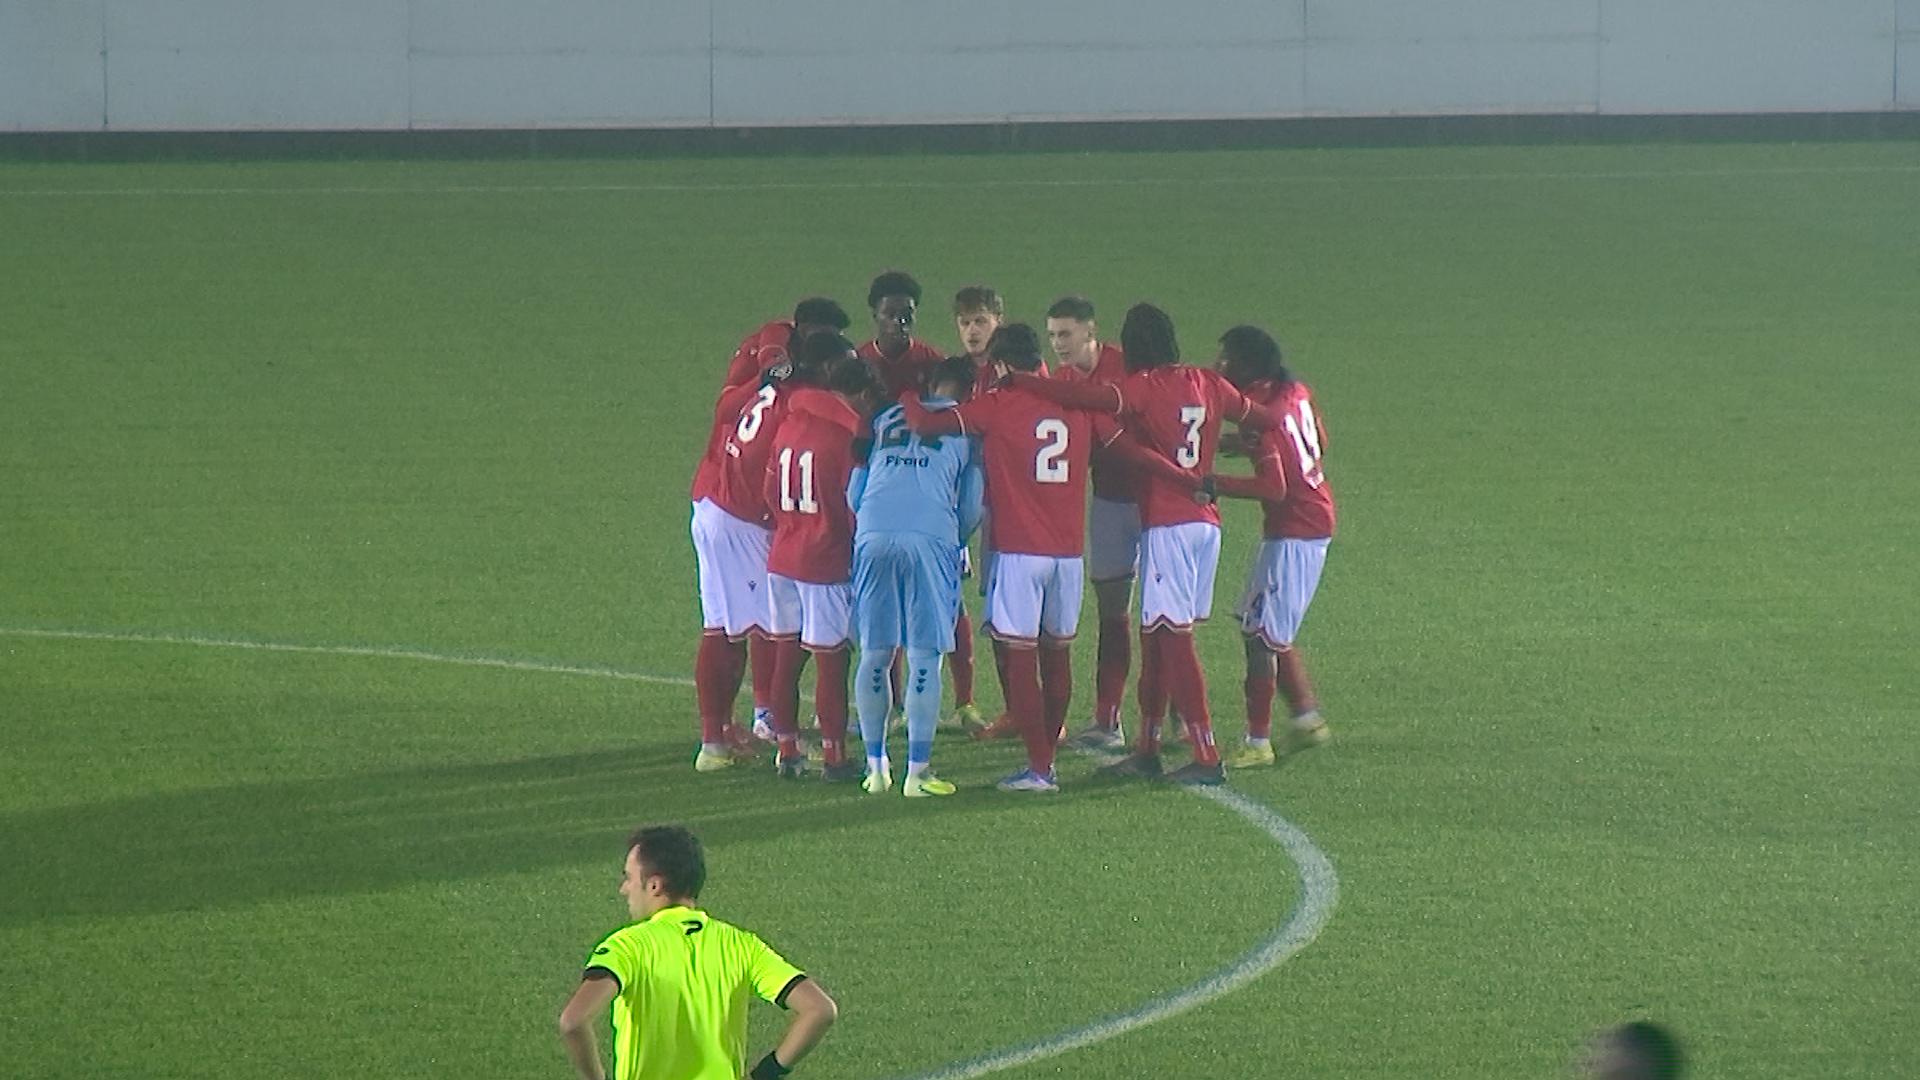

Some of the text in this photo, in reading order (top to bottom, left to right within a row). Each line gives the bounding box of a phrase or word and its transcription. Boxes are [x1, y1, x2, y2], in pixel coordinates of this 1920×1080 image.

[1035, 418, 1069, 483] 2
[1176, 406, 1206, 468] 3
[779, 448, 818, 513] 11
